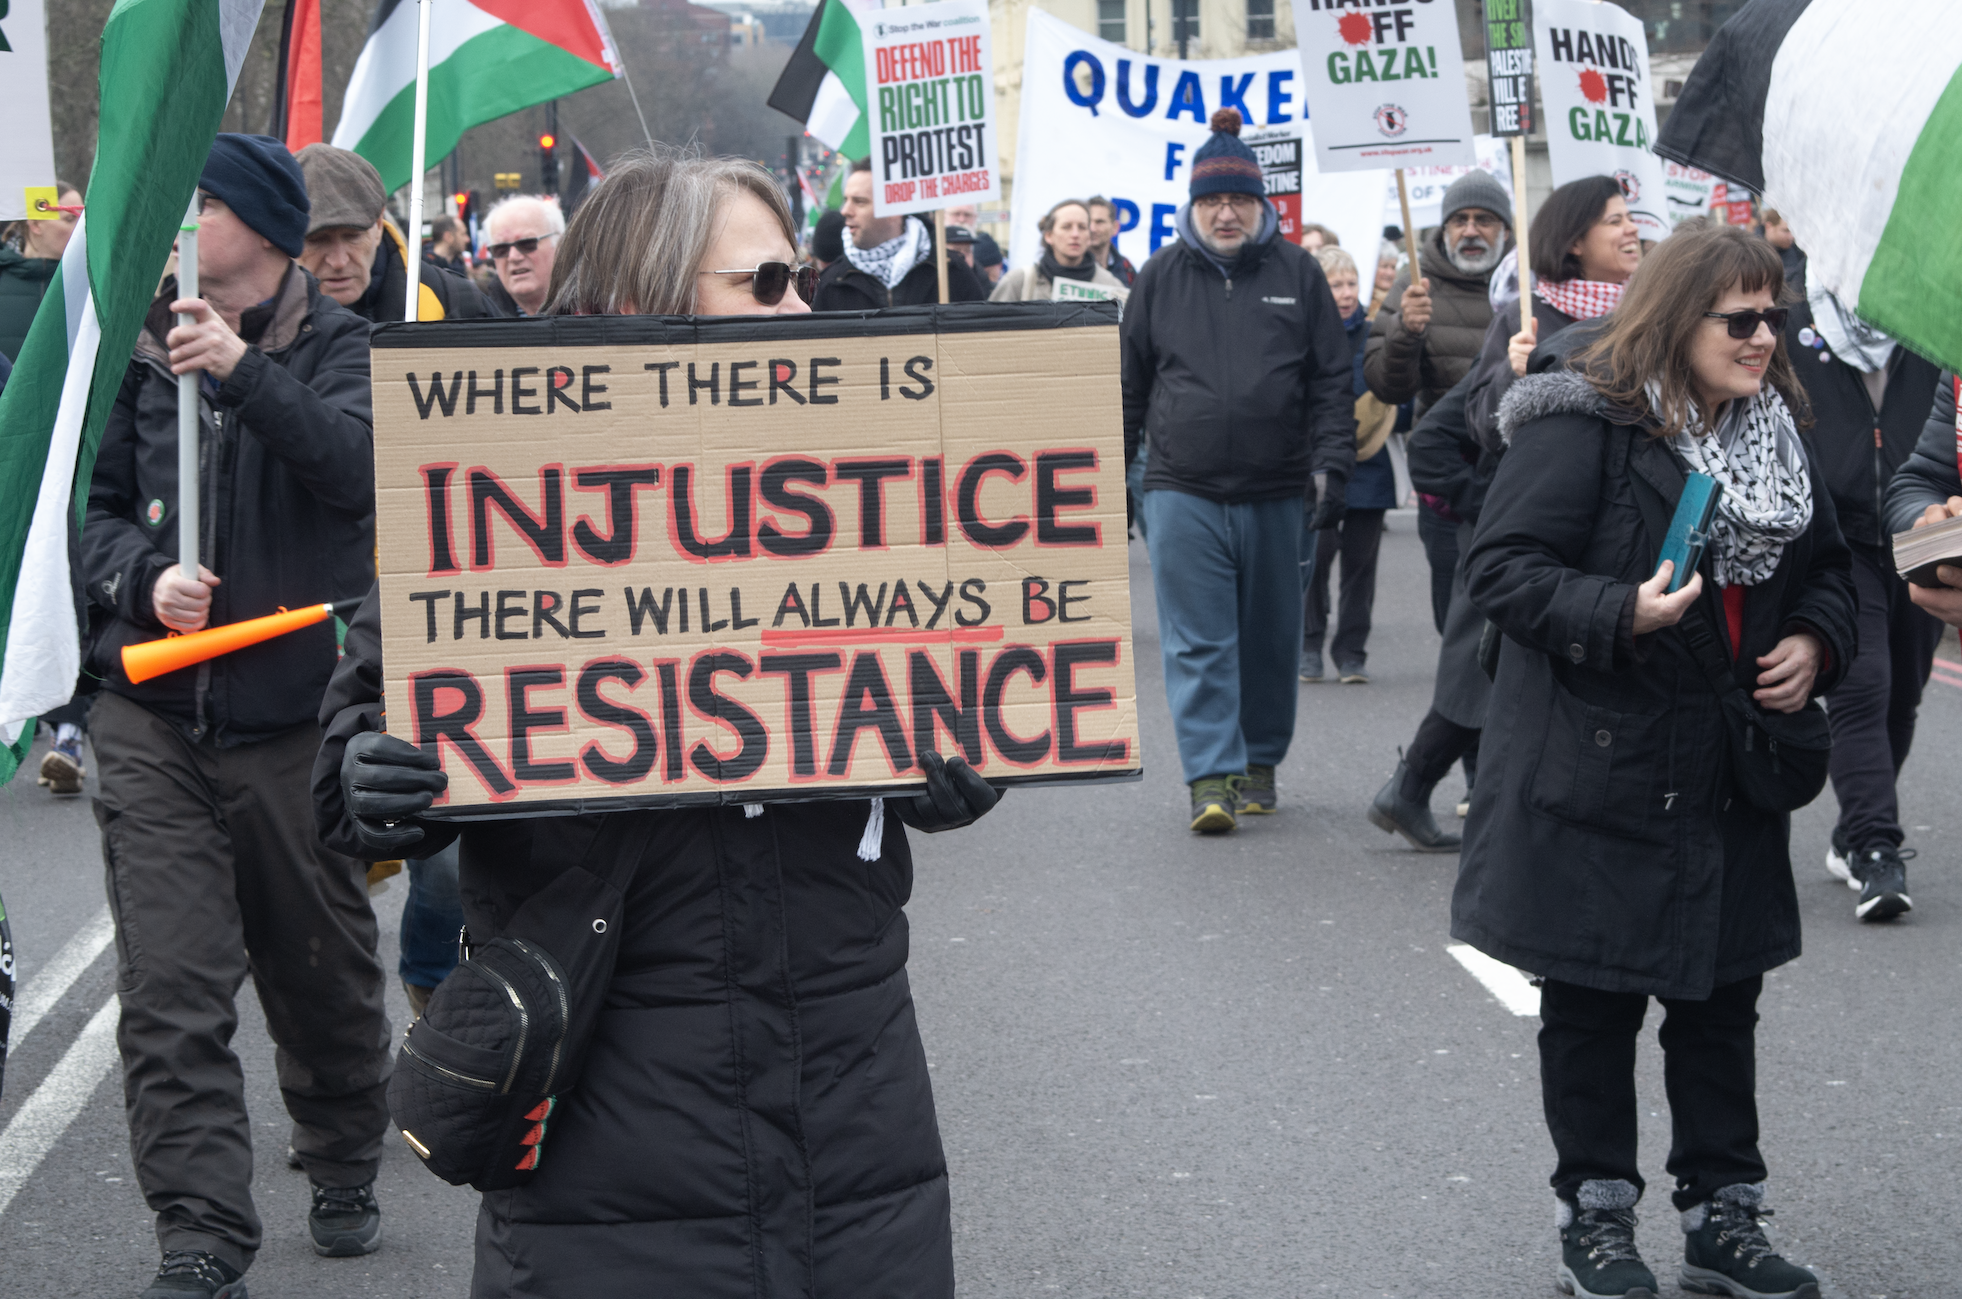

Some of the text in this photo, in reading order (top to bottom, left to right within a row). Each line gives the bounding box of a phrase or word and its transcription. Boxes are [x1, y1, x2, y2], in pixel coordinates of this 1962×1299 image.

[889, 16, 981, 35] Stop the War coalition
[875, 35, 982, 84] DEFEND THE
[1063, 49, 1310, 125] QUAKE
[1327, 46, 1439, 85] GAZA!
[878, 74, 985, 133] RIGHT TO
[882, 123, 985, 182] PROTEST
[885, 170, 989, 204] DROP THE CHARGES
[1261, 171, 1300, 194] STINE
[1059, 283, 1108, 301] ETHNIC
[406, 355, 936, 421] WHERE THERE IS
[418, 446, 1104, 578] INJUSTICE
[409, 575, 1093, 643] THERE WILL ALWAYS BE
[408, 638, 1130, 801] RESISTANCE
